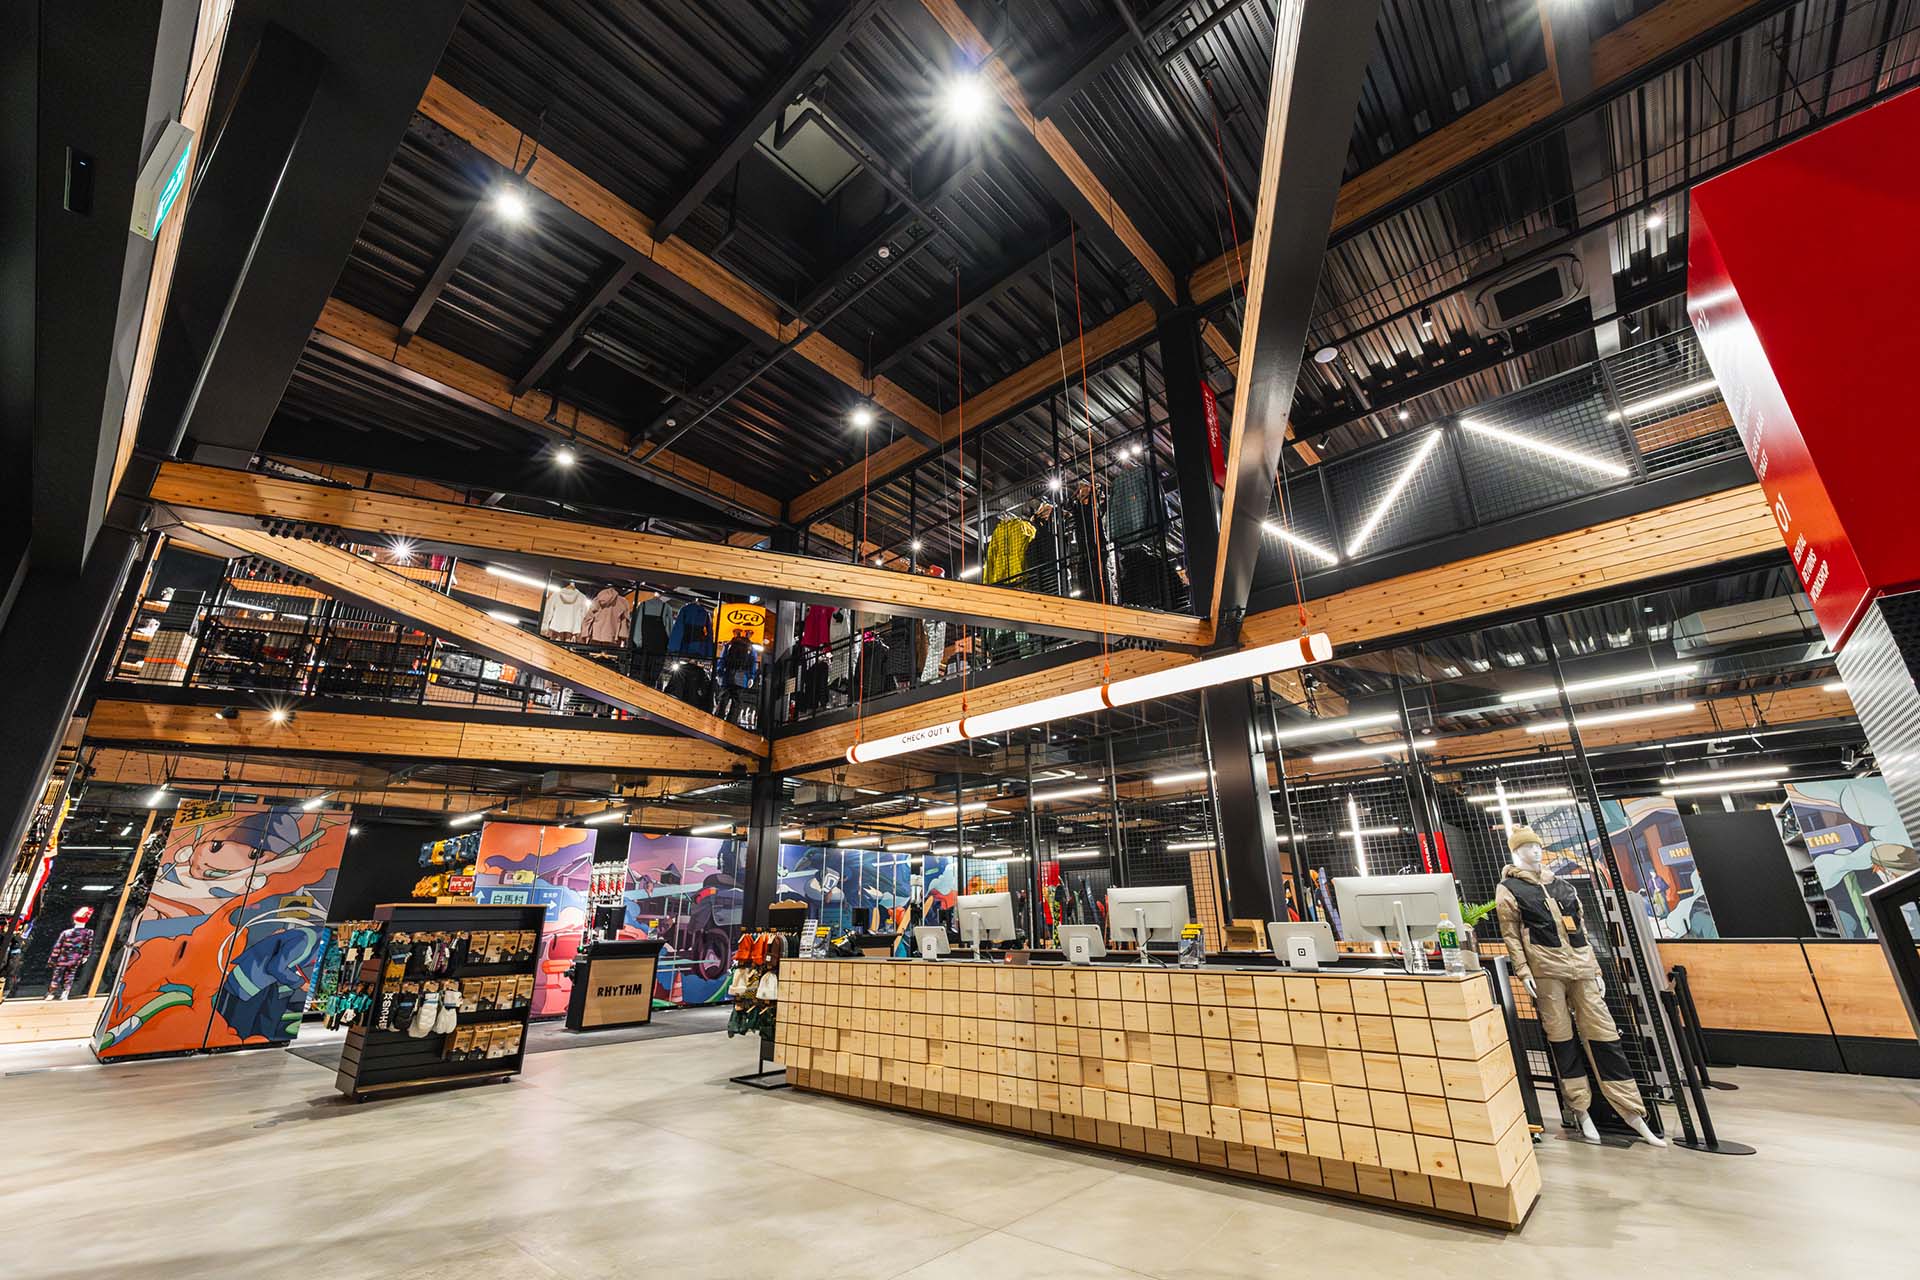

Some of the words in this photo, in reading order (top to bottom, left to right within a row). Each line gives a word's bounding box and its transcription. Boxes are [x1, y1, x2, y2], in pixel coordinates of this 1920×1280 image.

[1776, 492, 1792, 533] 01
[1810, 560, 1830, 603] WORKSHOP
[733, 610, 760, 622] bca
[901, 732, 926, 744] CHECK
[927, 727, 944, 738] OUT
[1807, 832, 1841, 848] THM
[493, 894, 524, 905] 白馬村
[597, 984, 642, 997] RHYTHM
